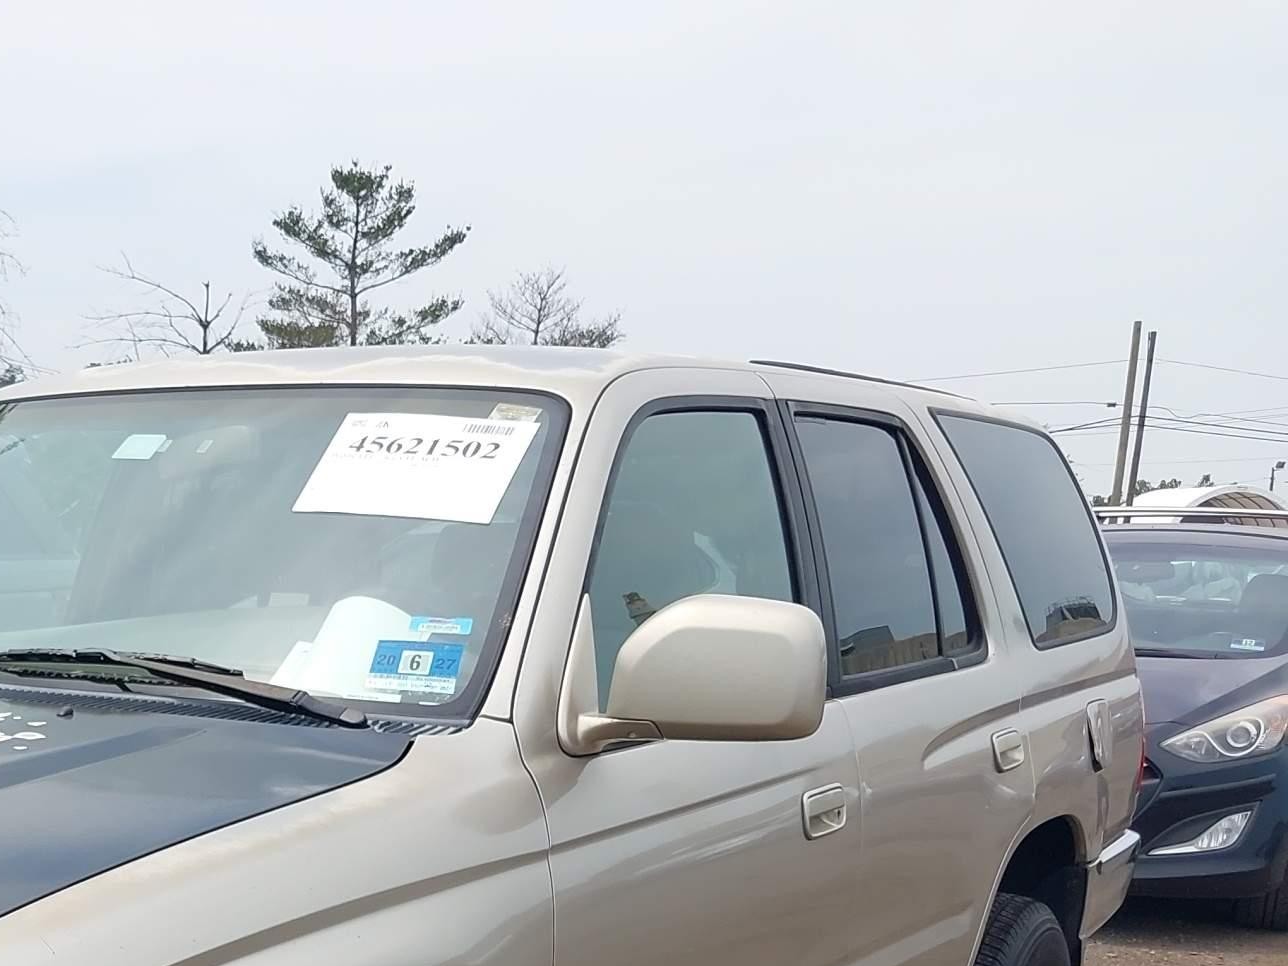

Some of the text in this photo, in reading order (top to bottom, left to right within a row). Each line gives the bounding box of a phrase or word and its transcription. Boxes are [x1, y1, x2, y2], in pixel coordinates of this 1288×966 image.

[349, 435, 501, 459] 45621502
[377, 654, 457, 671] 20 6 27
